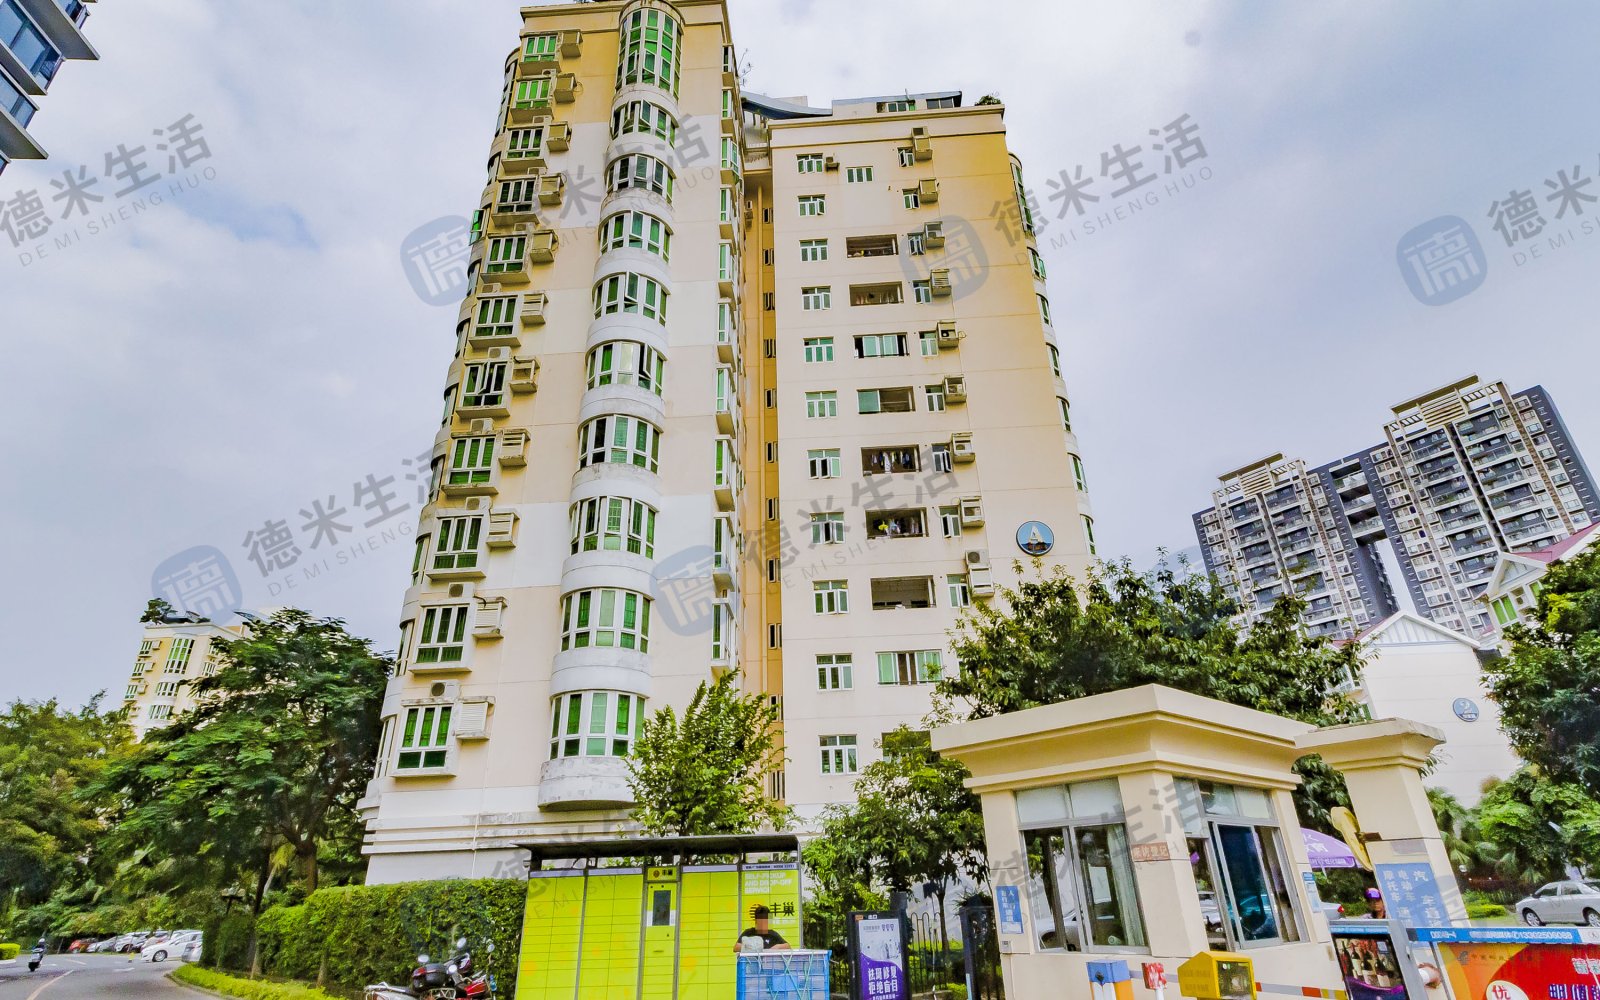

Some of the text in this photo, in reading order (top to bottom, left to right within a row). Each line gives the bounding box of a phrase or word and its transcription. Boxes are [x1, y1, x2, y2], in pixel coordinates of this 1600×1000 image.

[770, 901, 795, 917] 丰巢
[868, 979, 898, 995] 拒绝盲目
